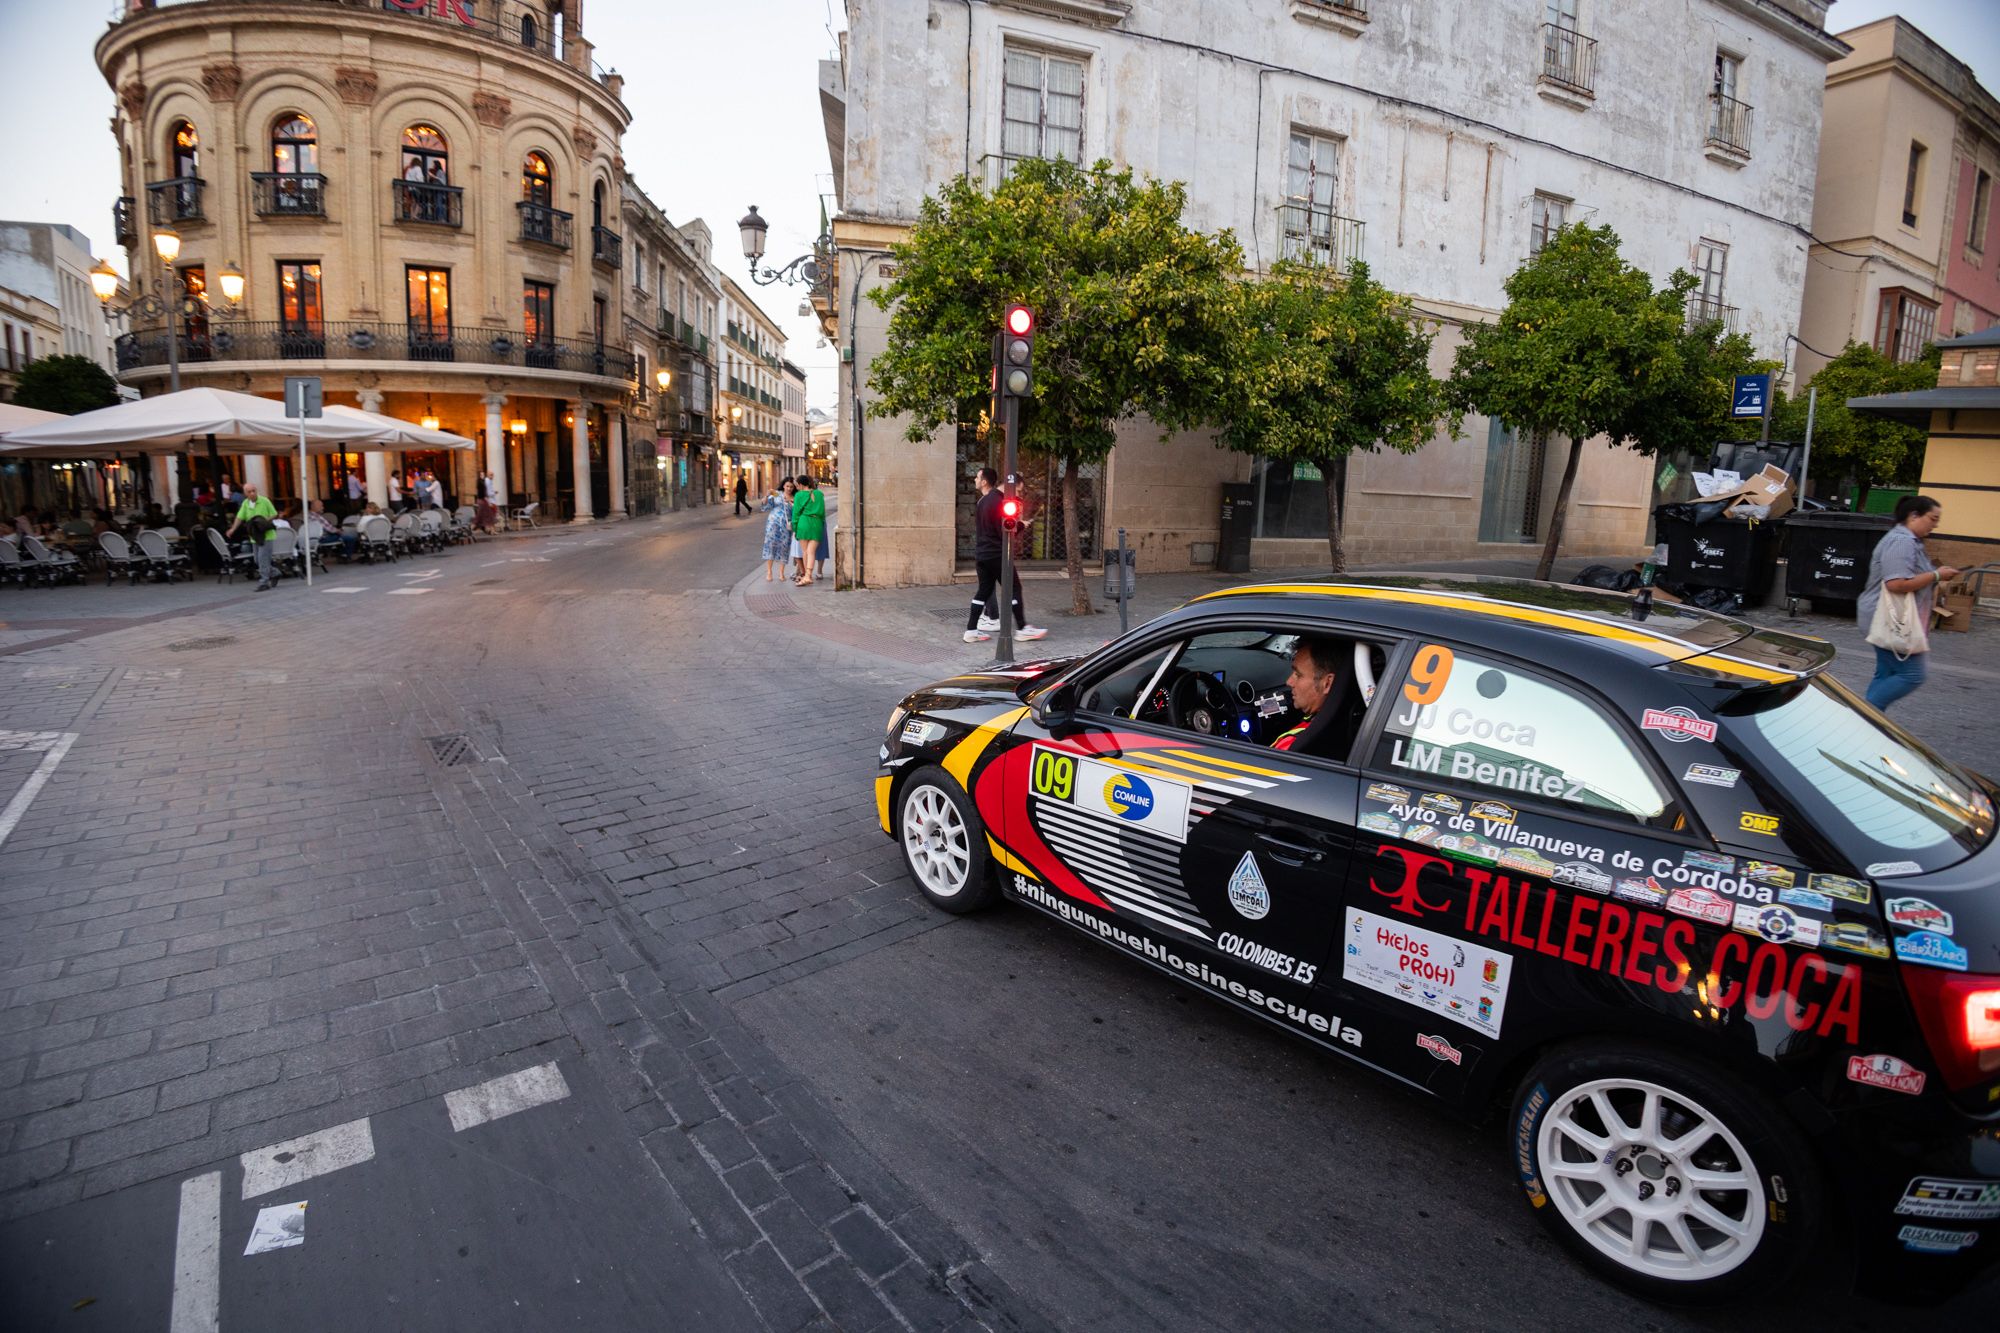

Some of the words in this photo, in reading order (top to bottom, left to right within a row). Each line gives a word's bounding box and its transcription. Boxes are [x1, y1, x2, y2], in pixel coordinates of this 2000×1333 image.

[1403, 644, 1455, 705] 9
[1398, 702, 1437, 730] JJ
[1447, 708, 1537, 748] Coca
[1035, 751, 1073, 800] 09
[1391, 739, 1441, 775] LM
[1450, 751, 1585, 803] Benítez
[1114, 789, 1150, 807] COMLINE
[1740, 815, 1779, 832] OMP
[1388, 804, 1441, 825] Ayto.
[1447, 813, 1475, 833] de
[1483, 819, 1605, 864] Villanueva
[1611, 850, 1645, 872] de
[1652, 858, 1773, 904] Córdoba
[1013, 874, 1364, 1048] #ningunpueblosinescuela
[1217, 931, 1318, 985] COLOMBES.ES
[1465, 867, 1696, 994] TALLERES
[1706, 933, 1863, 1045] COCA
[1898, 944, 1964, 961] GIBRALFARO
[1860, 1066, 1893, 1088] CARMEN
[1897, 1073, 1923, 1094] NONO
[1881, 1058, 1892, 1073] 6
[1518, 1091, 1545, 1176] MICHELIN
